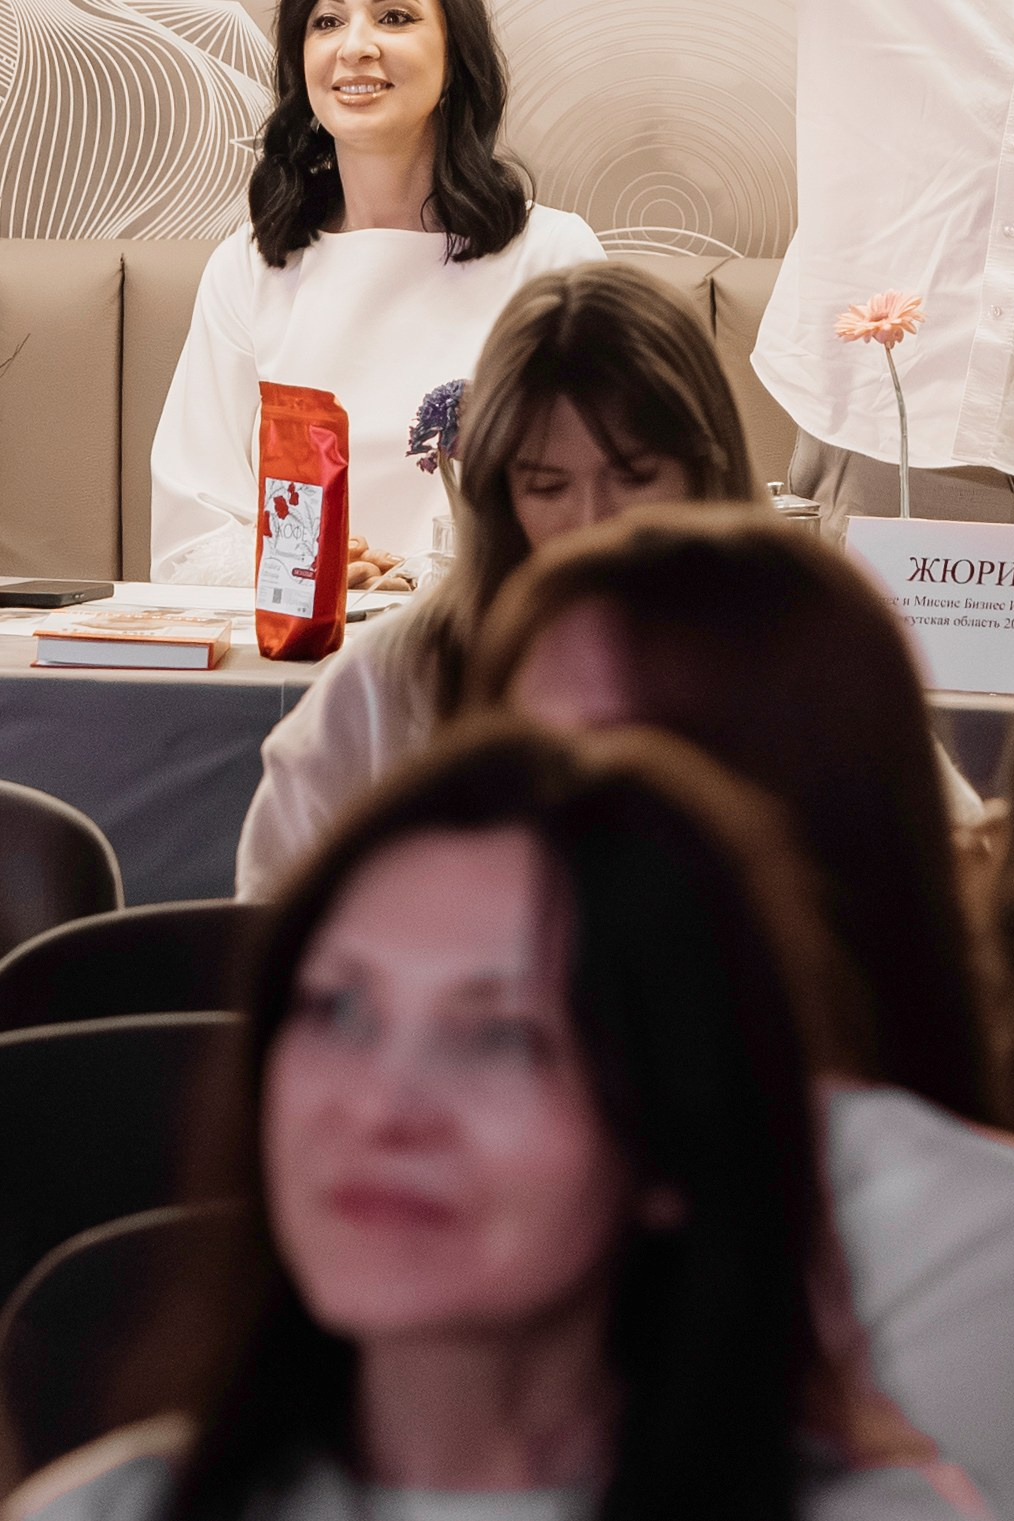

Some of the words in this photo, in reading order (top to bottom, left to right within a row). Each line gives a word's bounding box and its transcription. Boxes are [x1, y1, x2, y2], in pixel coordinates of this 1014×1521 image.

[902, 597, 910, 606] и
[914, 595, 960, 609] Миссис
[964, 598, 1006, 611] Бизнес
[953, 616, 1000, 629] область
